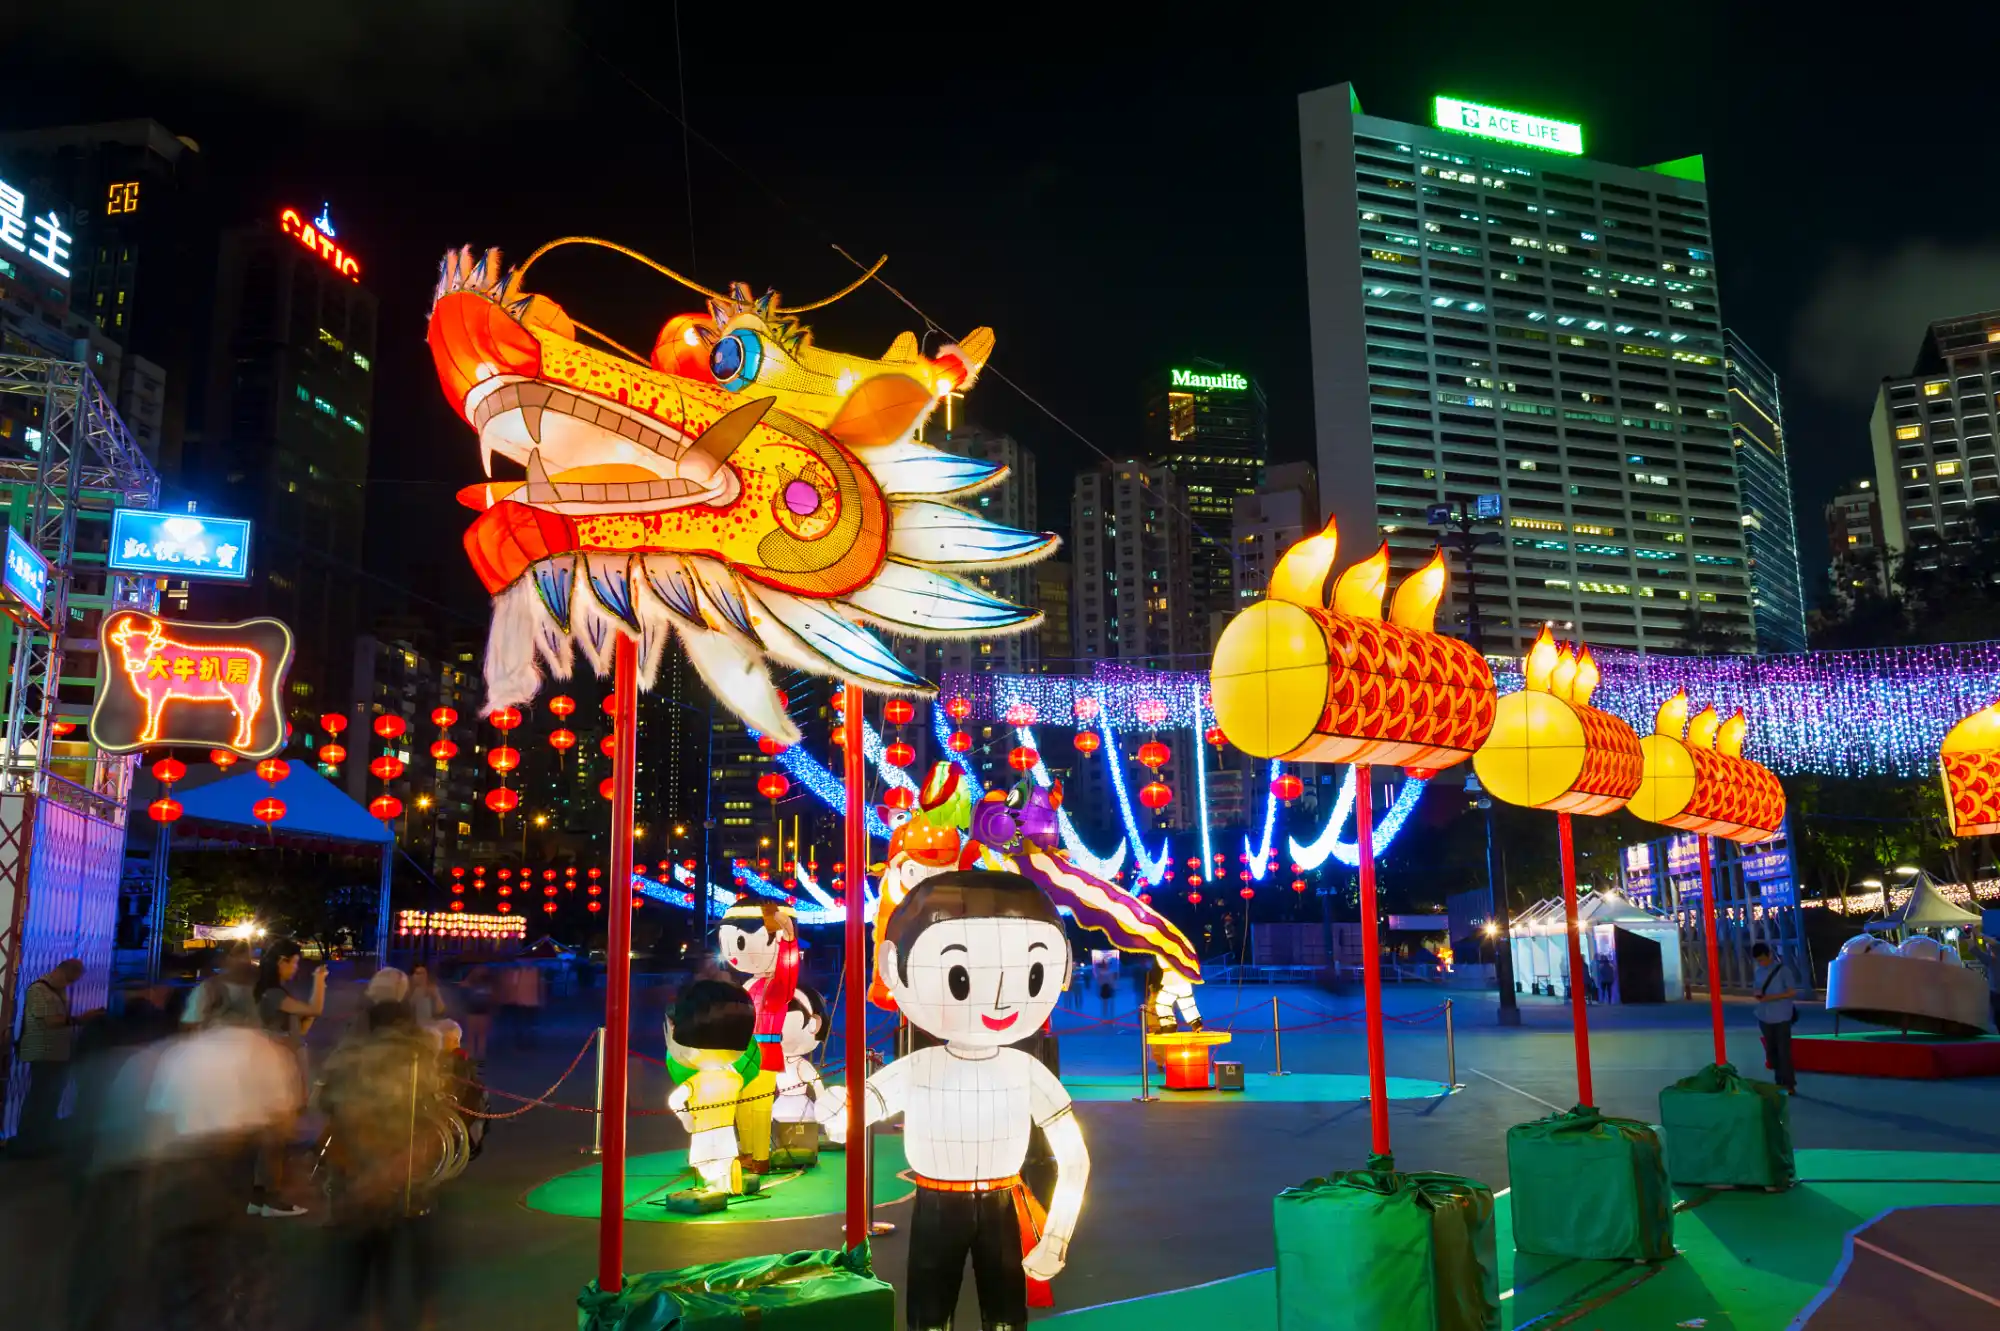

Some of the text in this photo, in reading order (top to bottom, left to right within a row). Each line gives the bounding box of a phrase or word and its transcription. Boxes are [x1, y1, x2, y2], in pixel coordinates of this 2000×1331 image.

[1488, 115, 1560, 142] ACE LIFE
[0, 178, 73, 278] 是主
[282, 209, 360, 283] CATIC
[1171, 368, 1248, 390] Manulife
[147, 654, 250, 685] 大牛扒房
